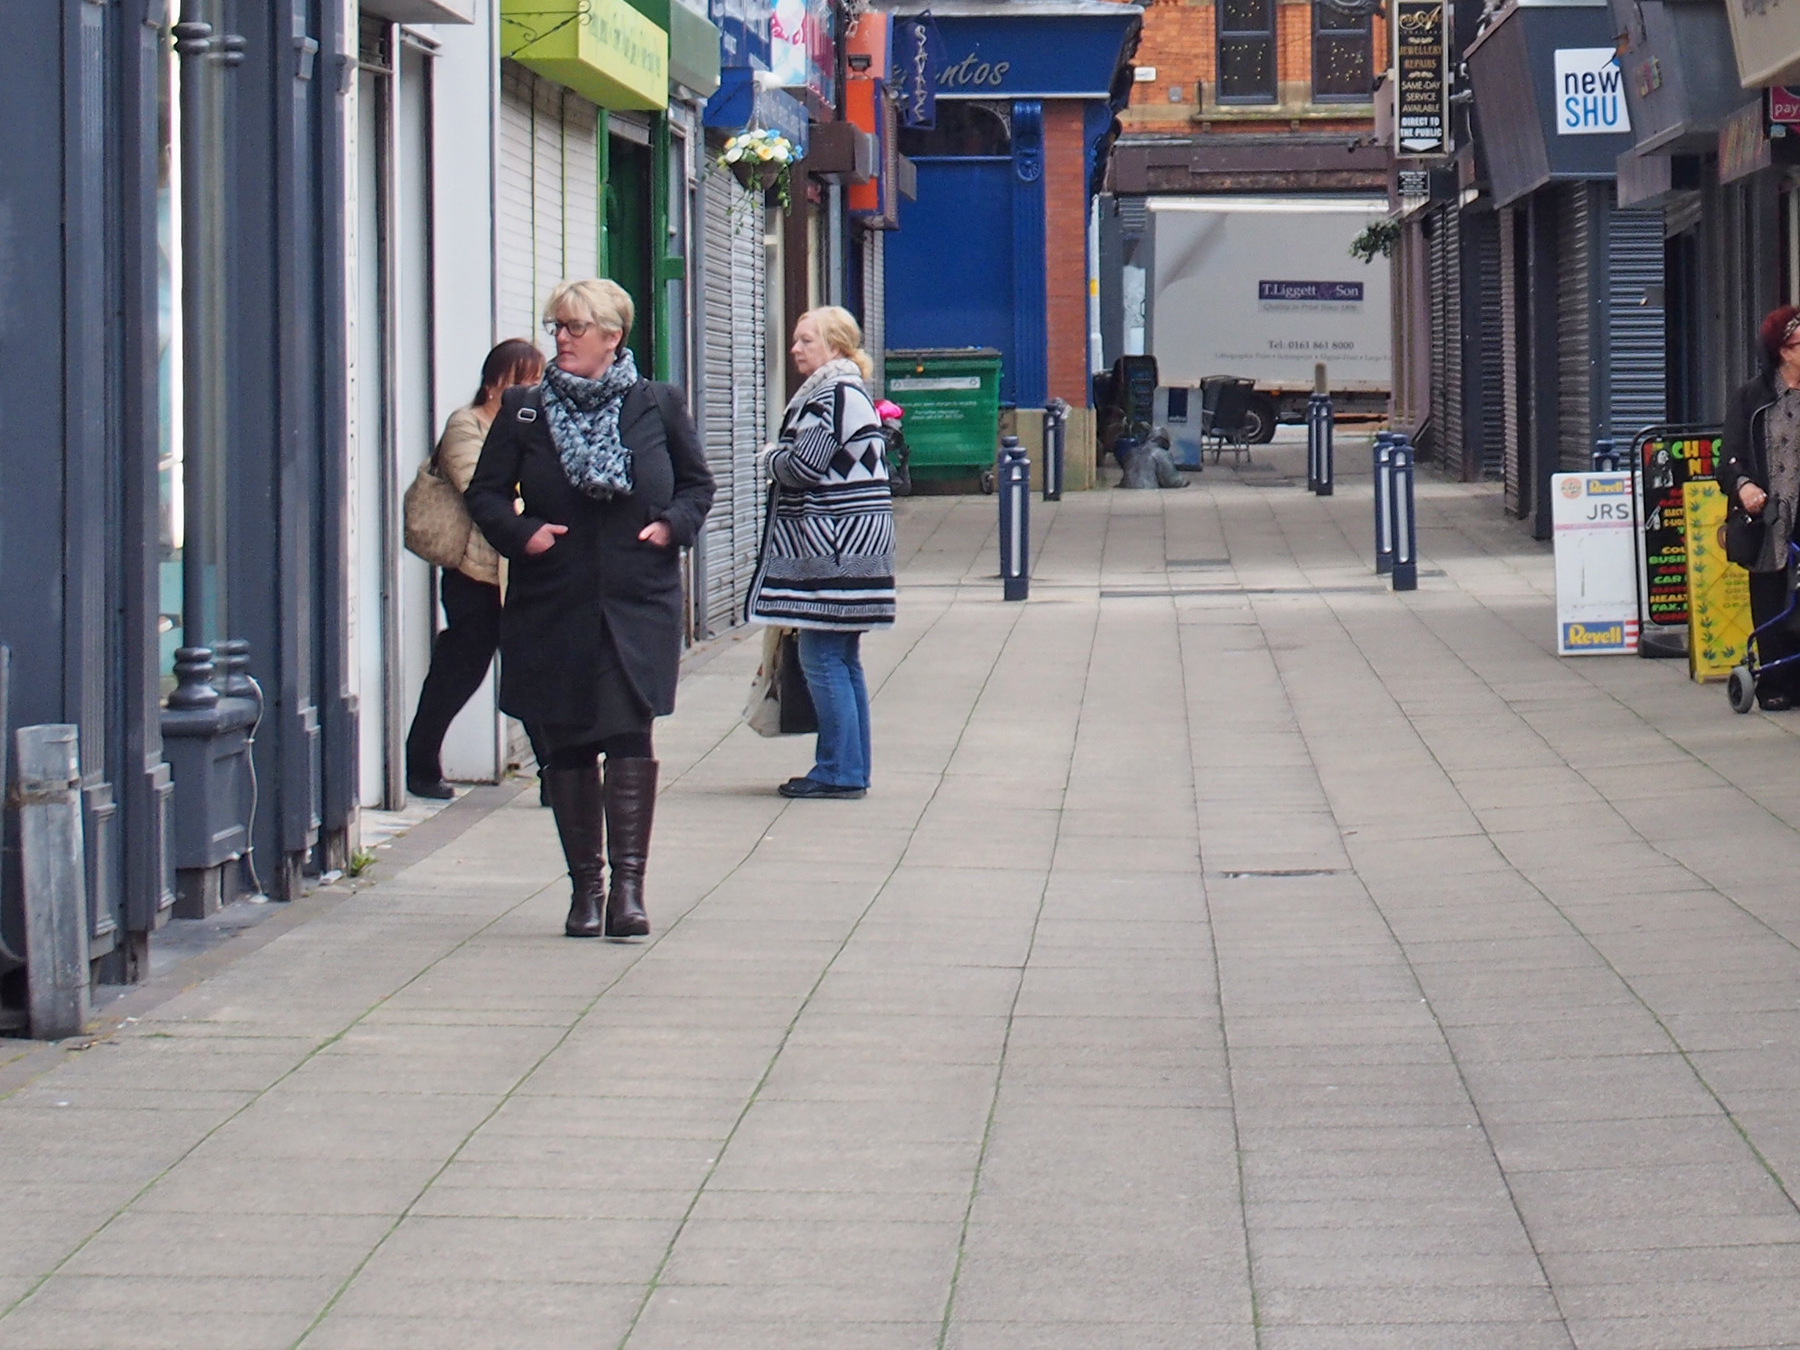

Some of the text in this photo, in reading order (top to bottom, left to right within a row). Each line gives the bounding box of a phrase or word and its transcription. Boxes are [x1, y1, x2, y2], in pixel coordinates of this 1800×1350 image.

[1403, 58, 1437, 69] REPAIRS
[935, 52, 1011, 87] ntos
[1401, 80, 1441, 90] SAME-DAY
[1564, 71, 1620, 95] new
[1405, 92, 1437, 102] SERVICE
[1401, 104, 1440, 113] AVAILABLE
[1565, 95, 1619, 127] SHU
[1401, 116, 1440, 126] DIRECT TO
[1400, 127, 1442, 137] THE PUBLIC
[1262, 283, 1317, 298] T.Liggett
[1335, 284, 1359, 297] Son
[1288, 340, 1310, 350] 0161
[1587, 503, 1630, 521] JRS
[1567, 624, 1622, 645] Revell
